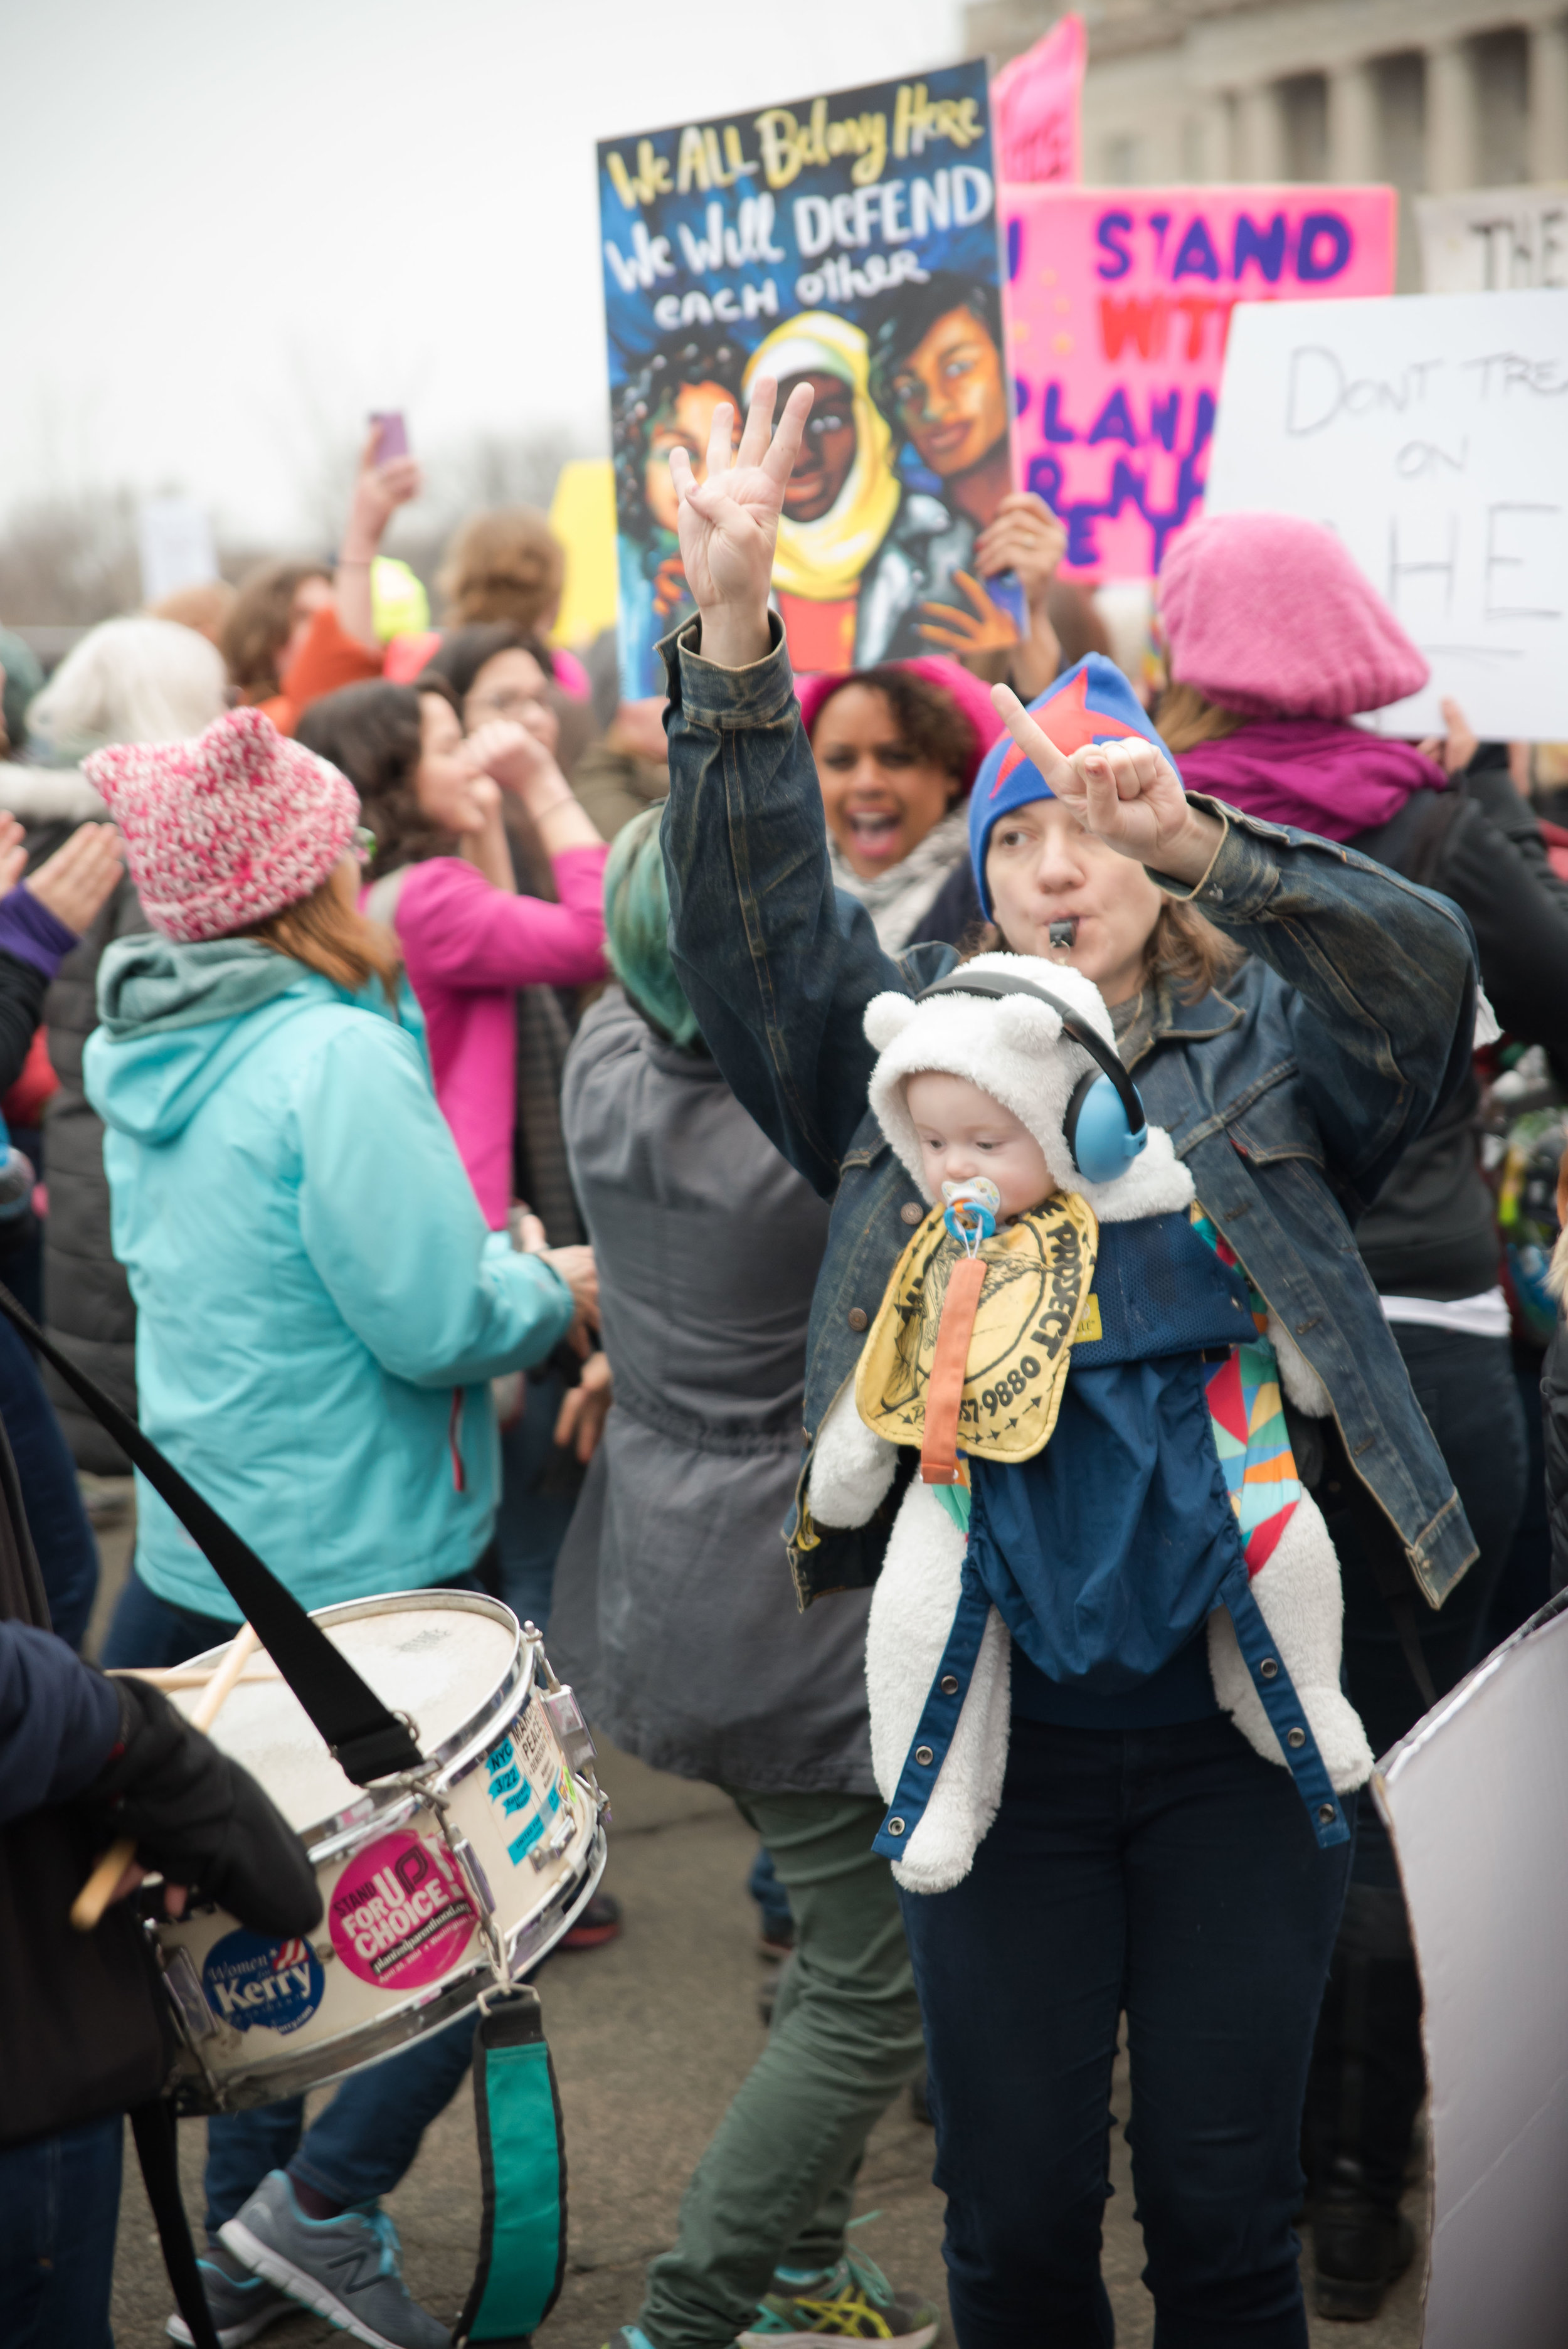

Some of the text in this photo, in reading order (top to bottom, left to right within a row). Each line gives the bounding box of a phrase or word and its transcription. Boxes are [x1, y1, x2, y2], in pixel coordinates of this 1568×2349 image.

[607, 139, 673, 208] We
[755, 98, 886, 189] Belong
[605, 221, 675, 292] We
[1098, 211, 1352, 282] STAND
[1030, 1219, 1083, 1360] PROJECT
[490, 1742, 514, 1770] NYC
[496, 1769, 518, 1793] 3/22
[333, 1881, 376, 1918] STAND
[341, 1896, 389, 1939] FOR
[208, 1954, 268, 1982] Women
[214, 1961, 312, 2013] Kerry
